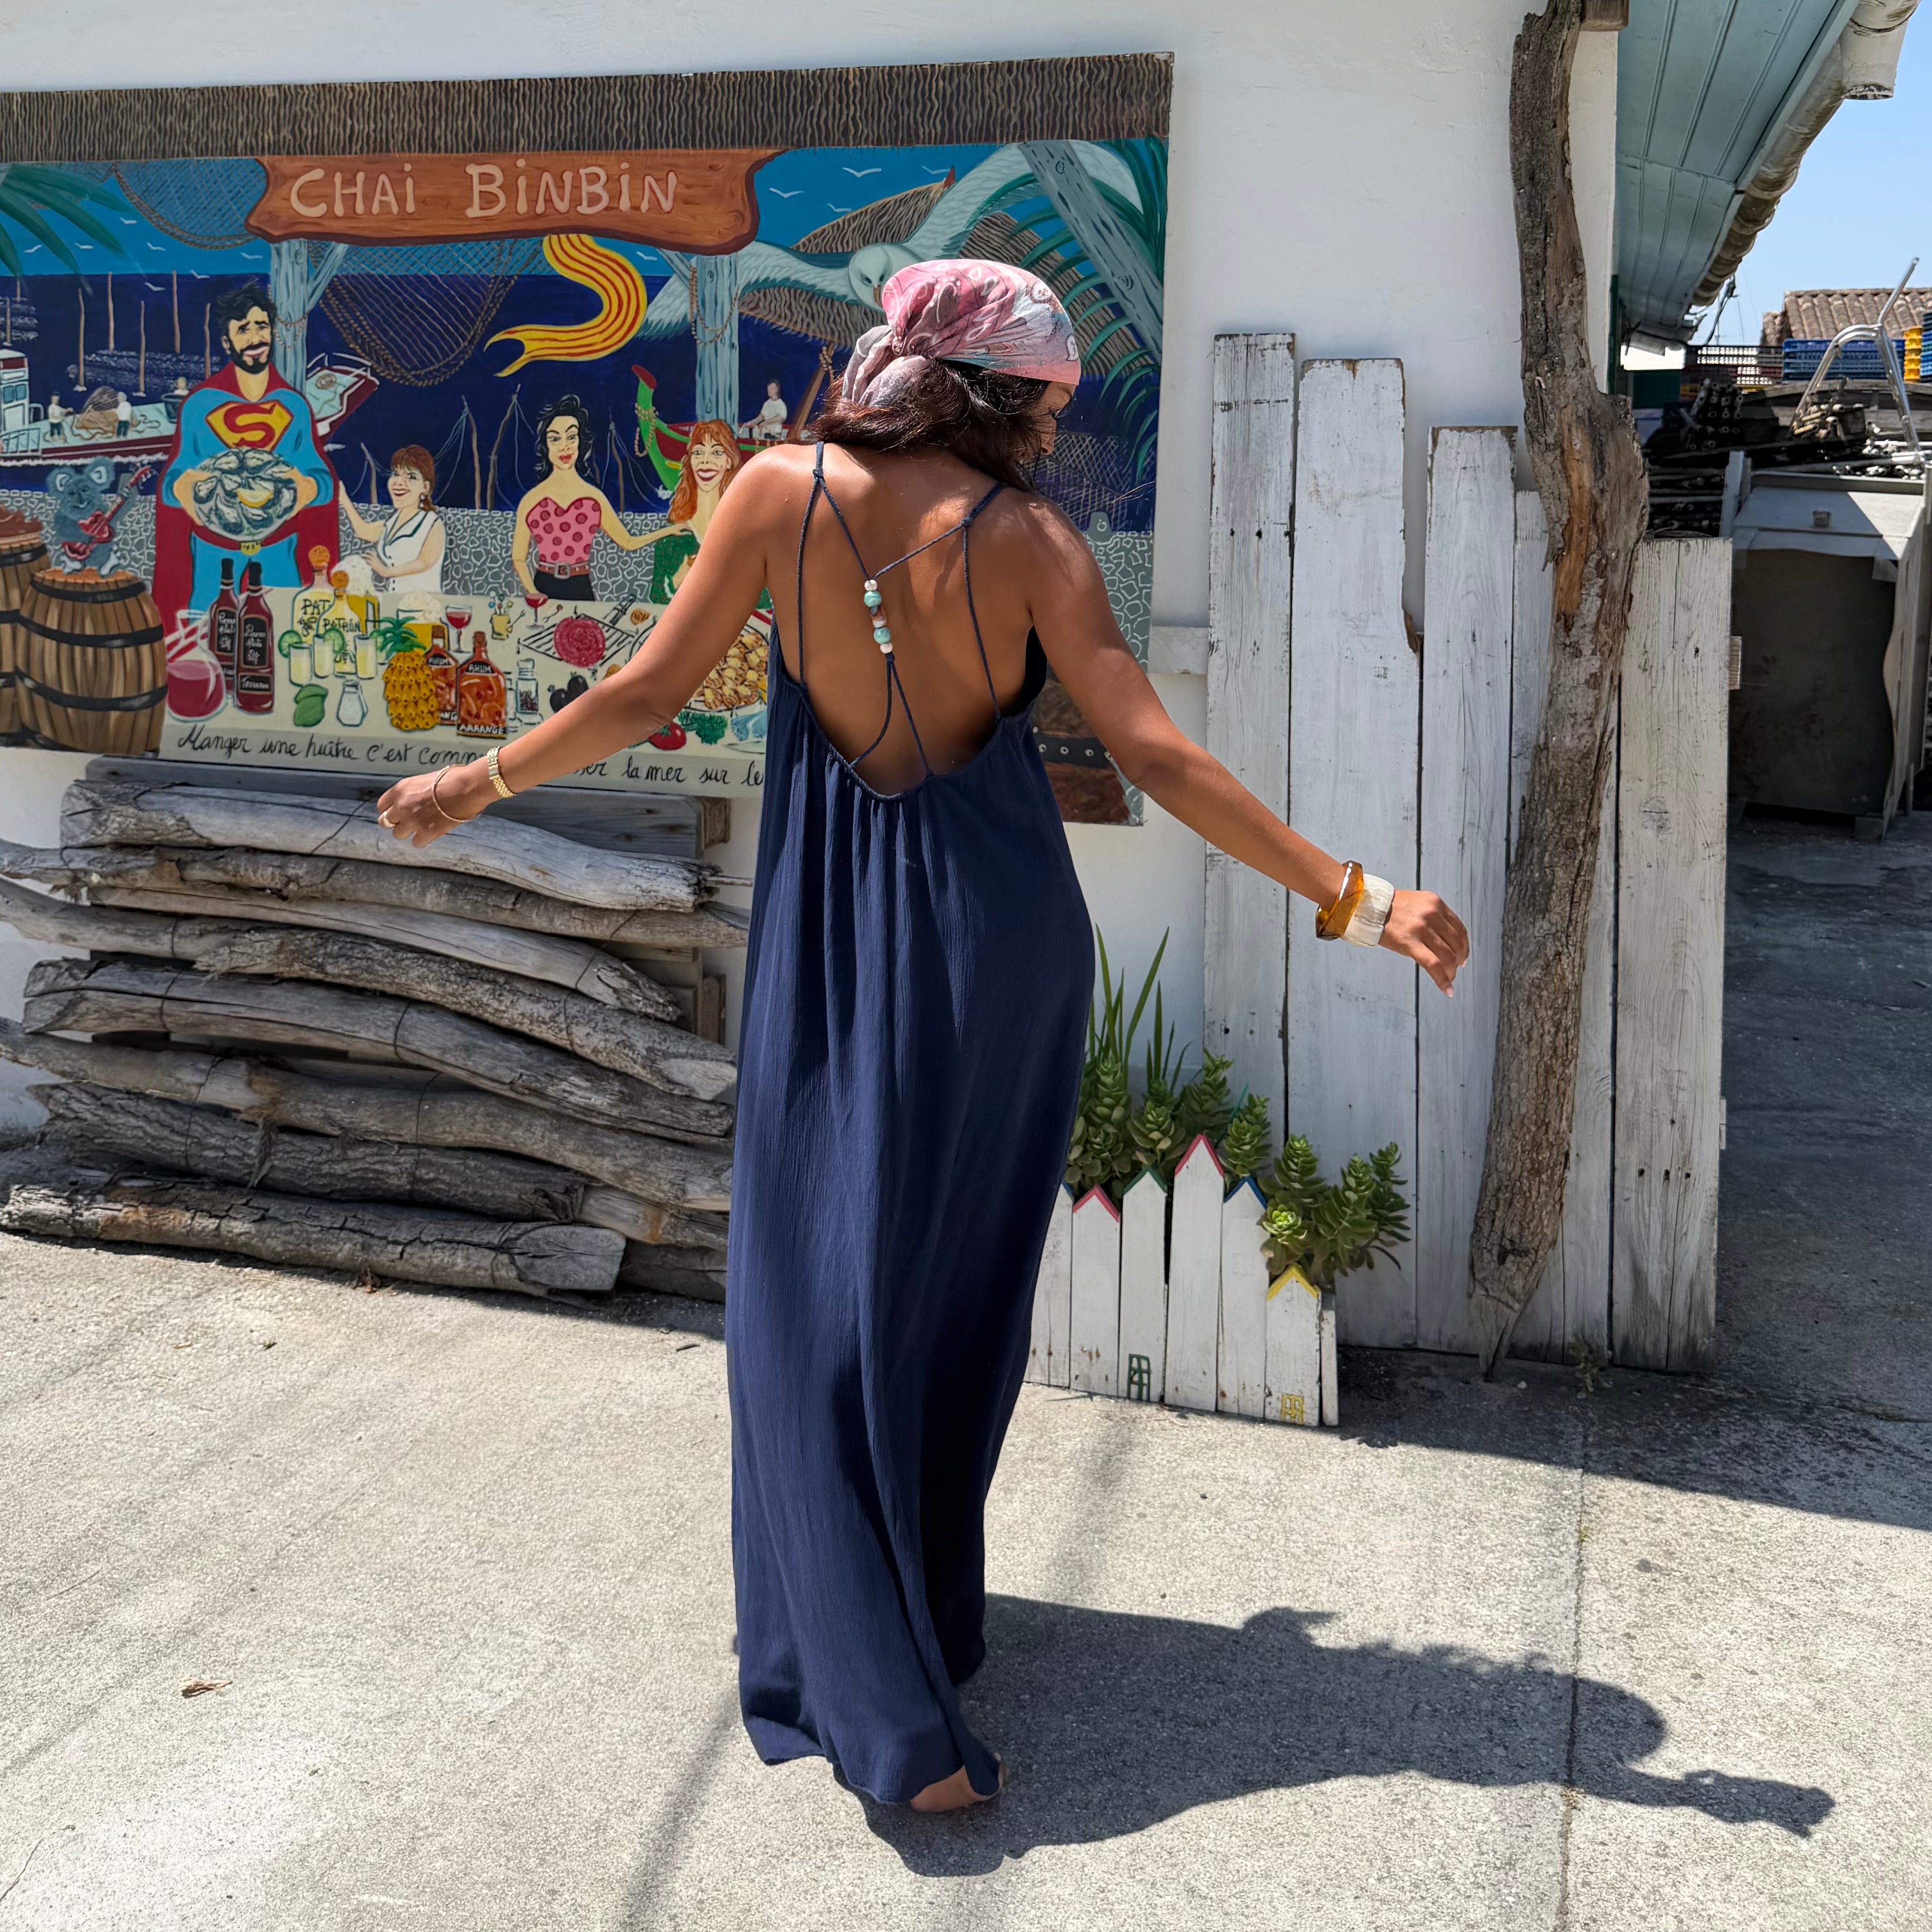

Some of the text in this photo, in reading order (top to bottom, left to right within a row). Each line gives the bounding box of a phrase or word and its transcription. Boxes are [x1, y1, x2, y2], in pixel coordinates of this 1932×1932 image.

[301, 599, 331, 615] PAT
[178, 724, 251, 759] Manger
[259, 738, 302, 756] une
[645, 764, 687, 783] mer
[698, 767, 731, 784] sur
